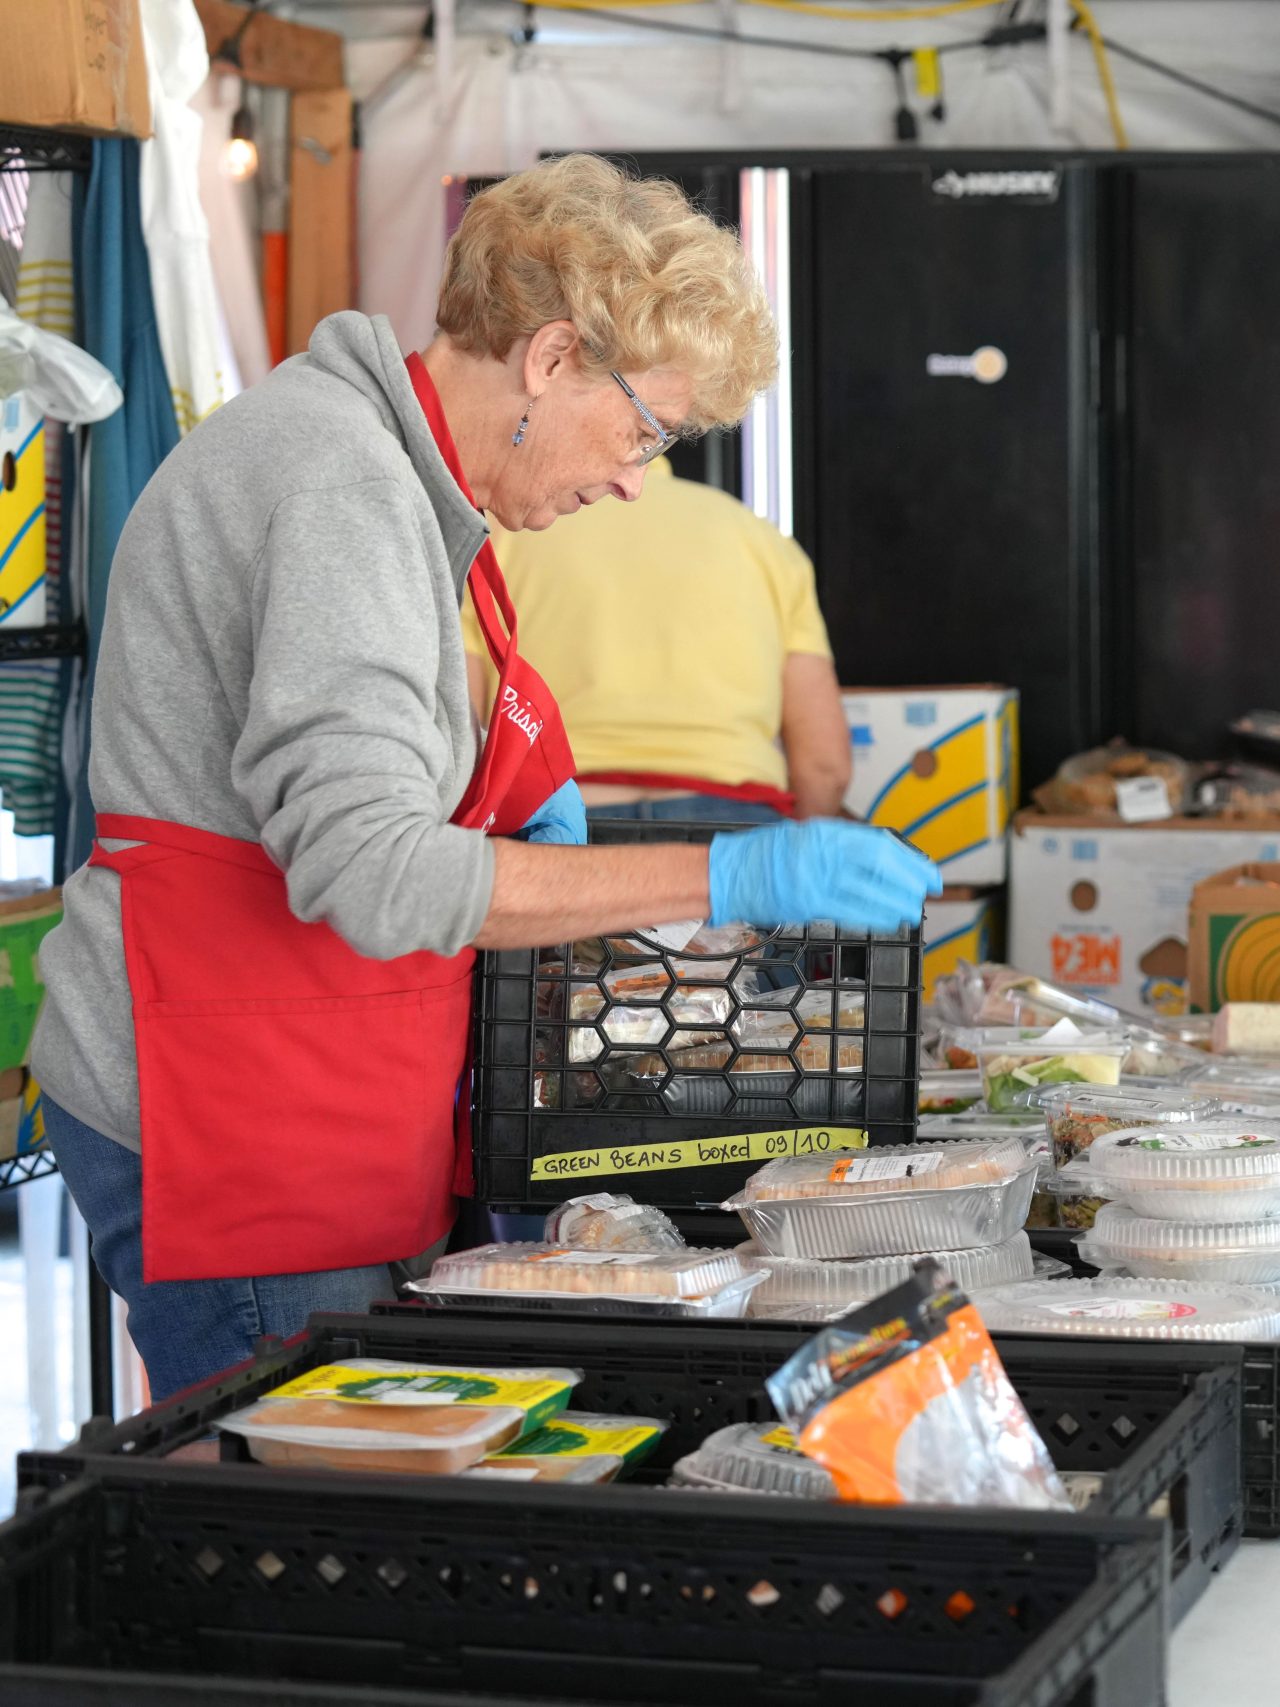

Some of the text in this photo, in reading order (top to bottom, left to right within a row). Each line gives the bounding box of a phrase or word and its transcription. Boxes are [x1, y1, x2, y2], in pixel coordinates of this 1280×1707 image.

[544, 1129, 831, 1174] GREEN BEANS boxed 09/10
